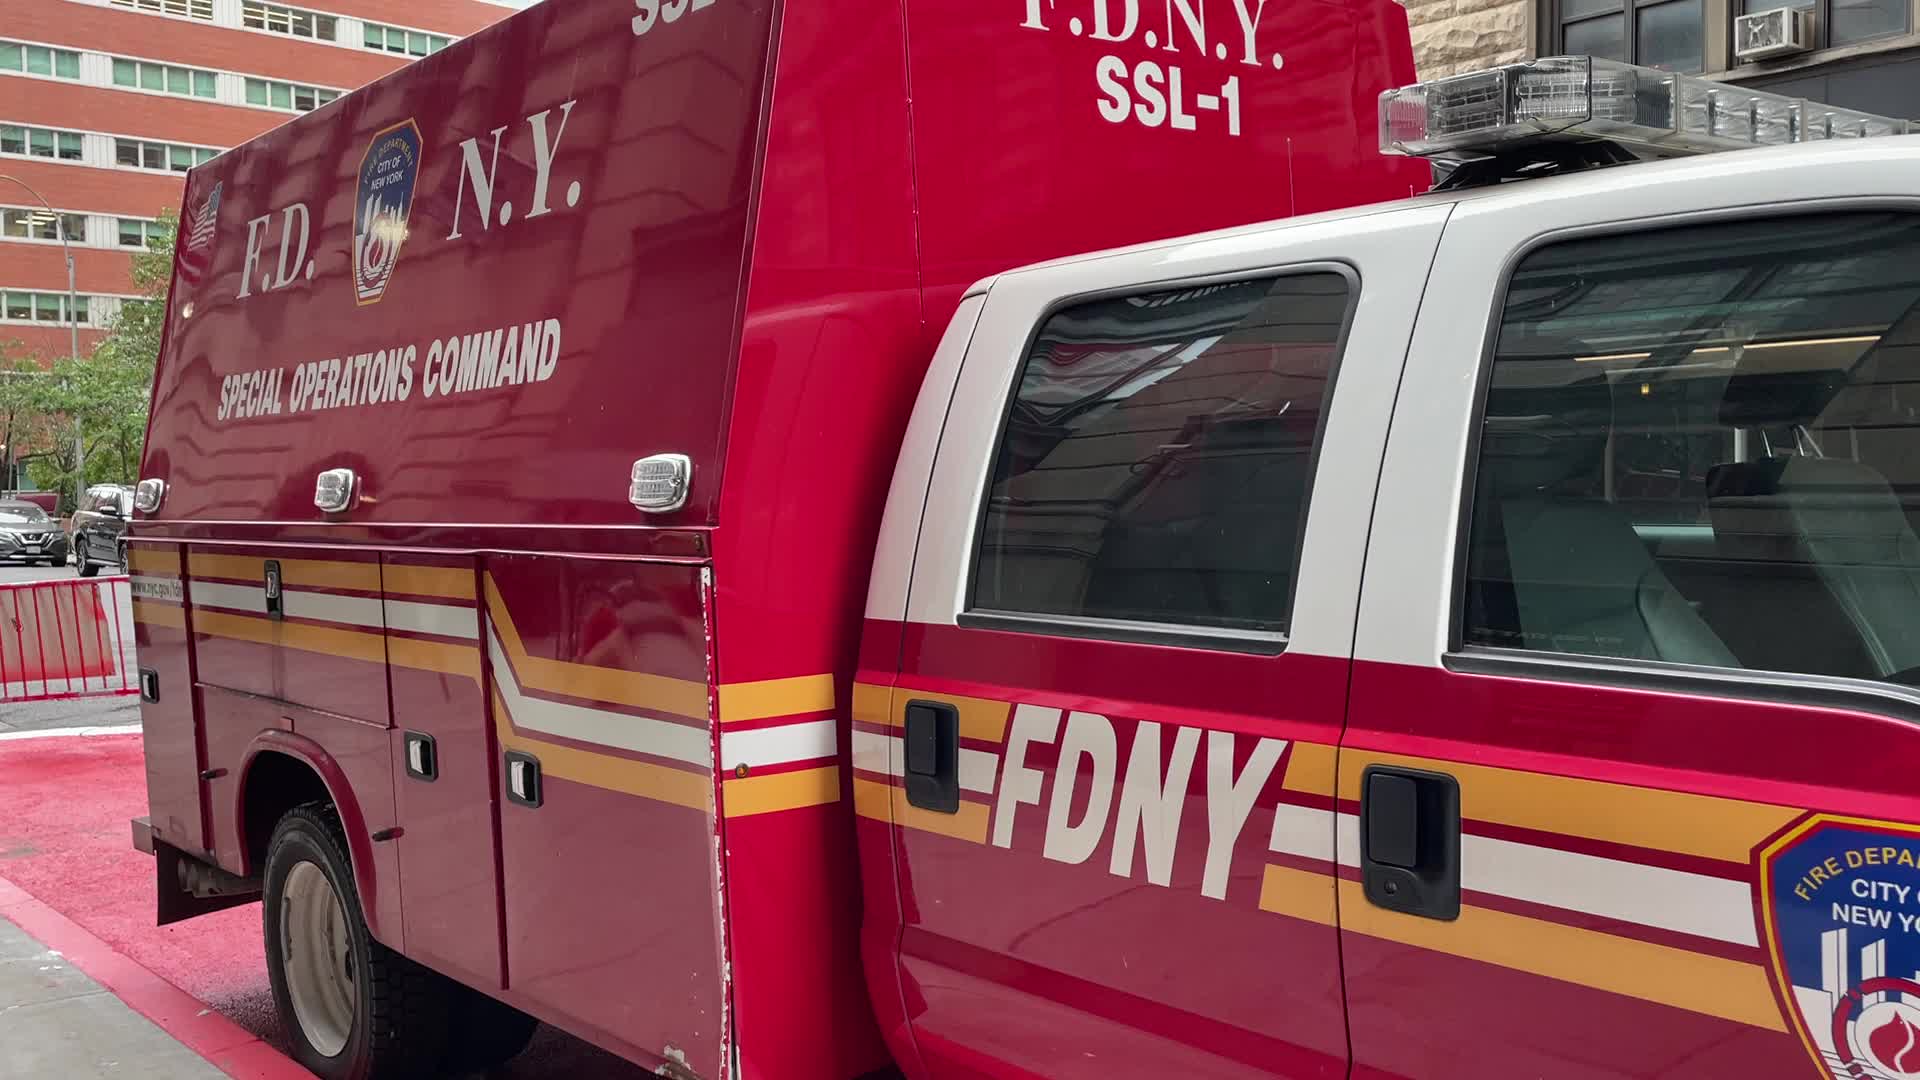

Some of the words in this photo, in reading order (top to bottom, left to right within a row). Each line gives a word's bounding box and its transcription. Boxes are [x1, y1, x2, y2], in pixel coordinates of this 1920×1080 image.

[1096, 55, 1241, 136] SSL-1
[378, 138, 413, 168] DEPARTMENT
[378, 159, 392, 174] CITY
[391, 155, 402, 169] OF
[371, 177, 386, 191] NEW
[386, 170, 404, 184] YORK
[236, 202, 315, 299] F.D.
[446, 100, 581, 240] N.Y.
[217, 366, 284, 421] SPECIAL
[288, 344, 416, 414] OPERATIONS
[422, 317, 561, 399] COMMAND
[991, 702, 1289, 901] FDNY
[1794, 857, 1843, 901] FIRE
[1851, 878, 1910, 904] CITY
[1832, 902, 1891, 928] NEW
